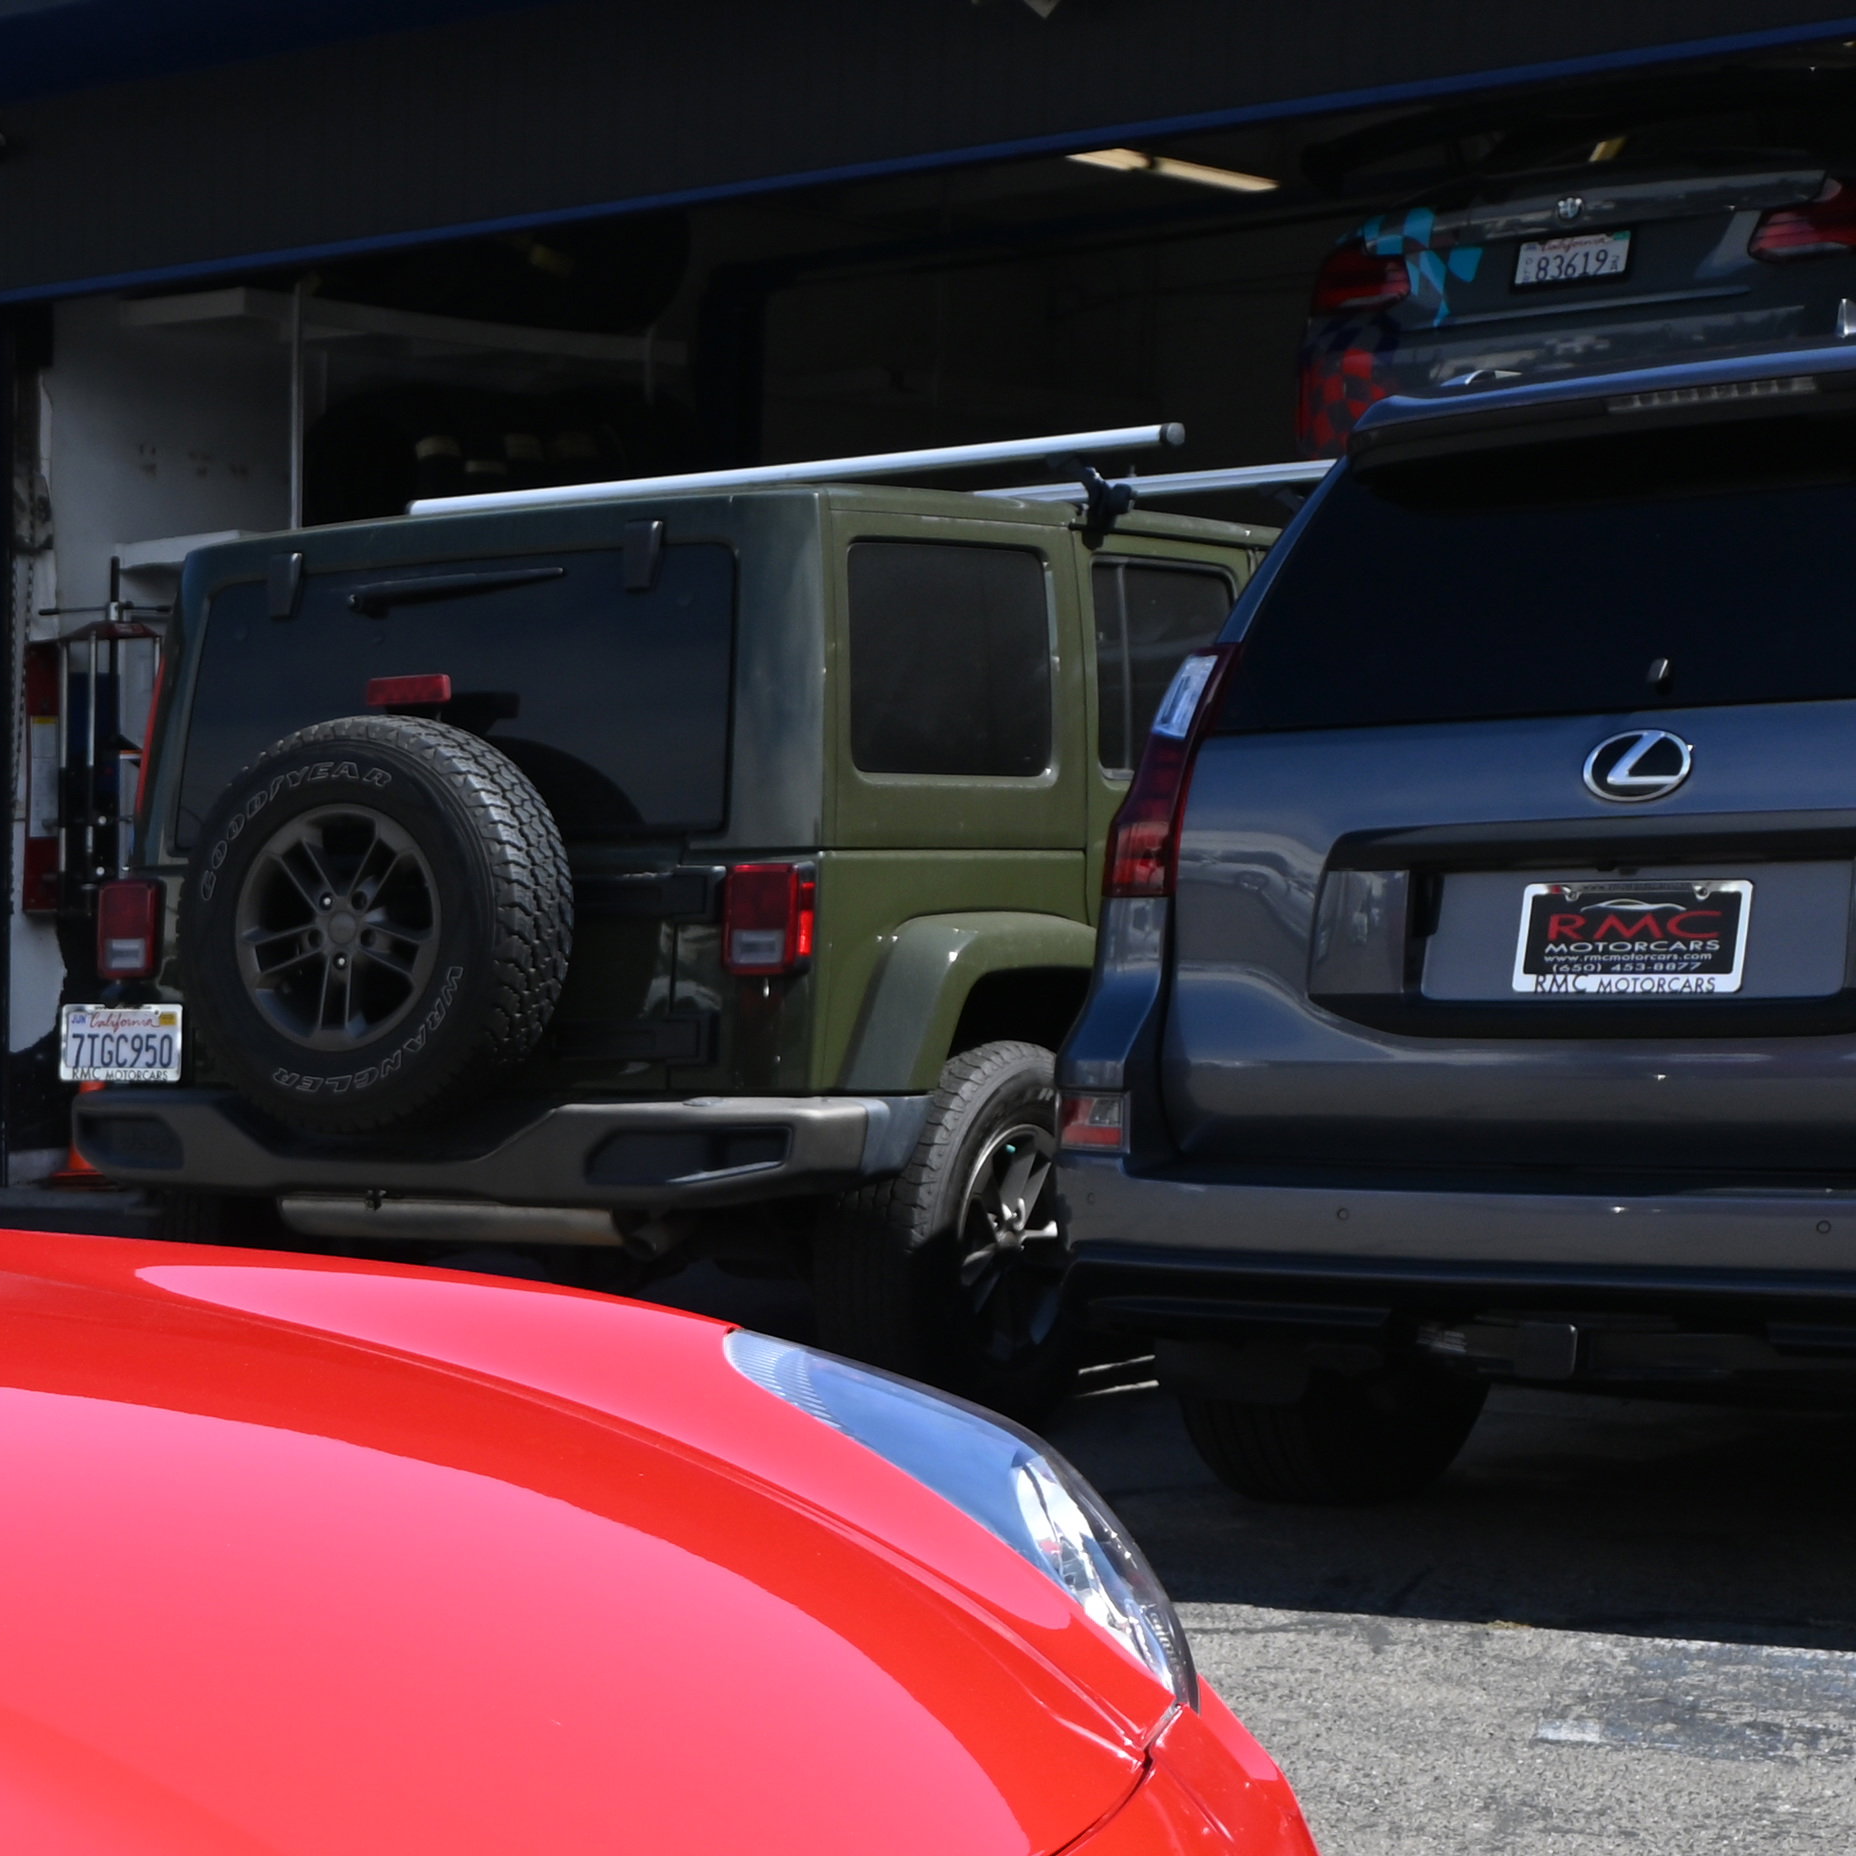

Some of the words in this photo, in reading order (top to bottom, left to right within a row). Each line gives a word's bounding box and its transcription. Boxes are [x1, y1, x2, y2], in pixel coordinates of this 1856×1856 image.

[1535, 249, 1609, 282] 83619
[200, 760, 393, 901] GOODYEAR
[1547, 910, 1722, 941] RMC
[1544, 940, 1720, 954] MOTORCARS
[1544, 952, 1712, 962] www.rmcmotorcars.com
[1552, 963, 1602, 972] (650)
[1610, 961, 1702, 972] 453-8877
[1535, 974, 1588, 993] RMC
[1597, 976, 1717, 994] MOTORCARS
[89, 1011, 161, 1033] California
[272, 966, 463, 1093] WRANGLER
[72, 1033, 173, 1068] 7TGC950
[72, 1067, 102, 1081] RMC
[105, 1069, 168, 1081] MOTORCARS
